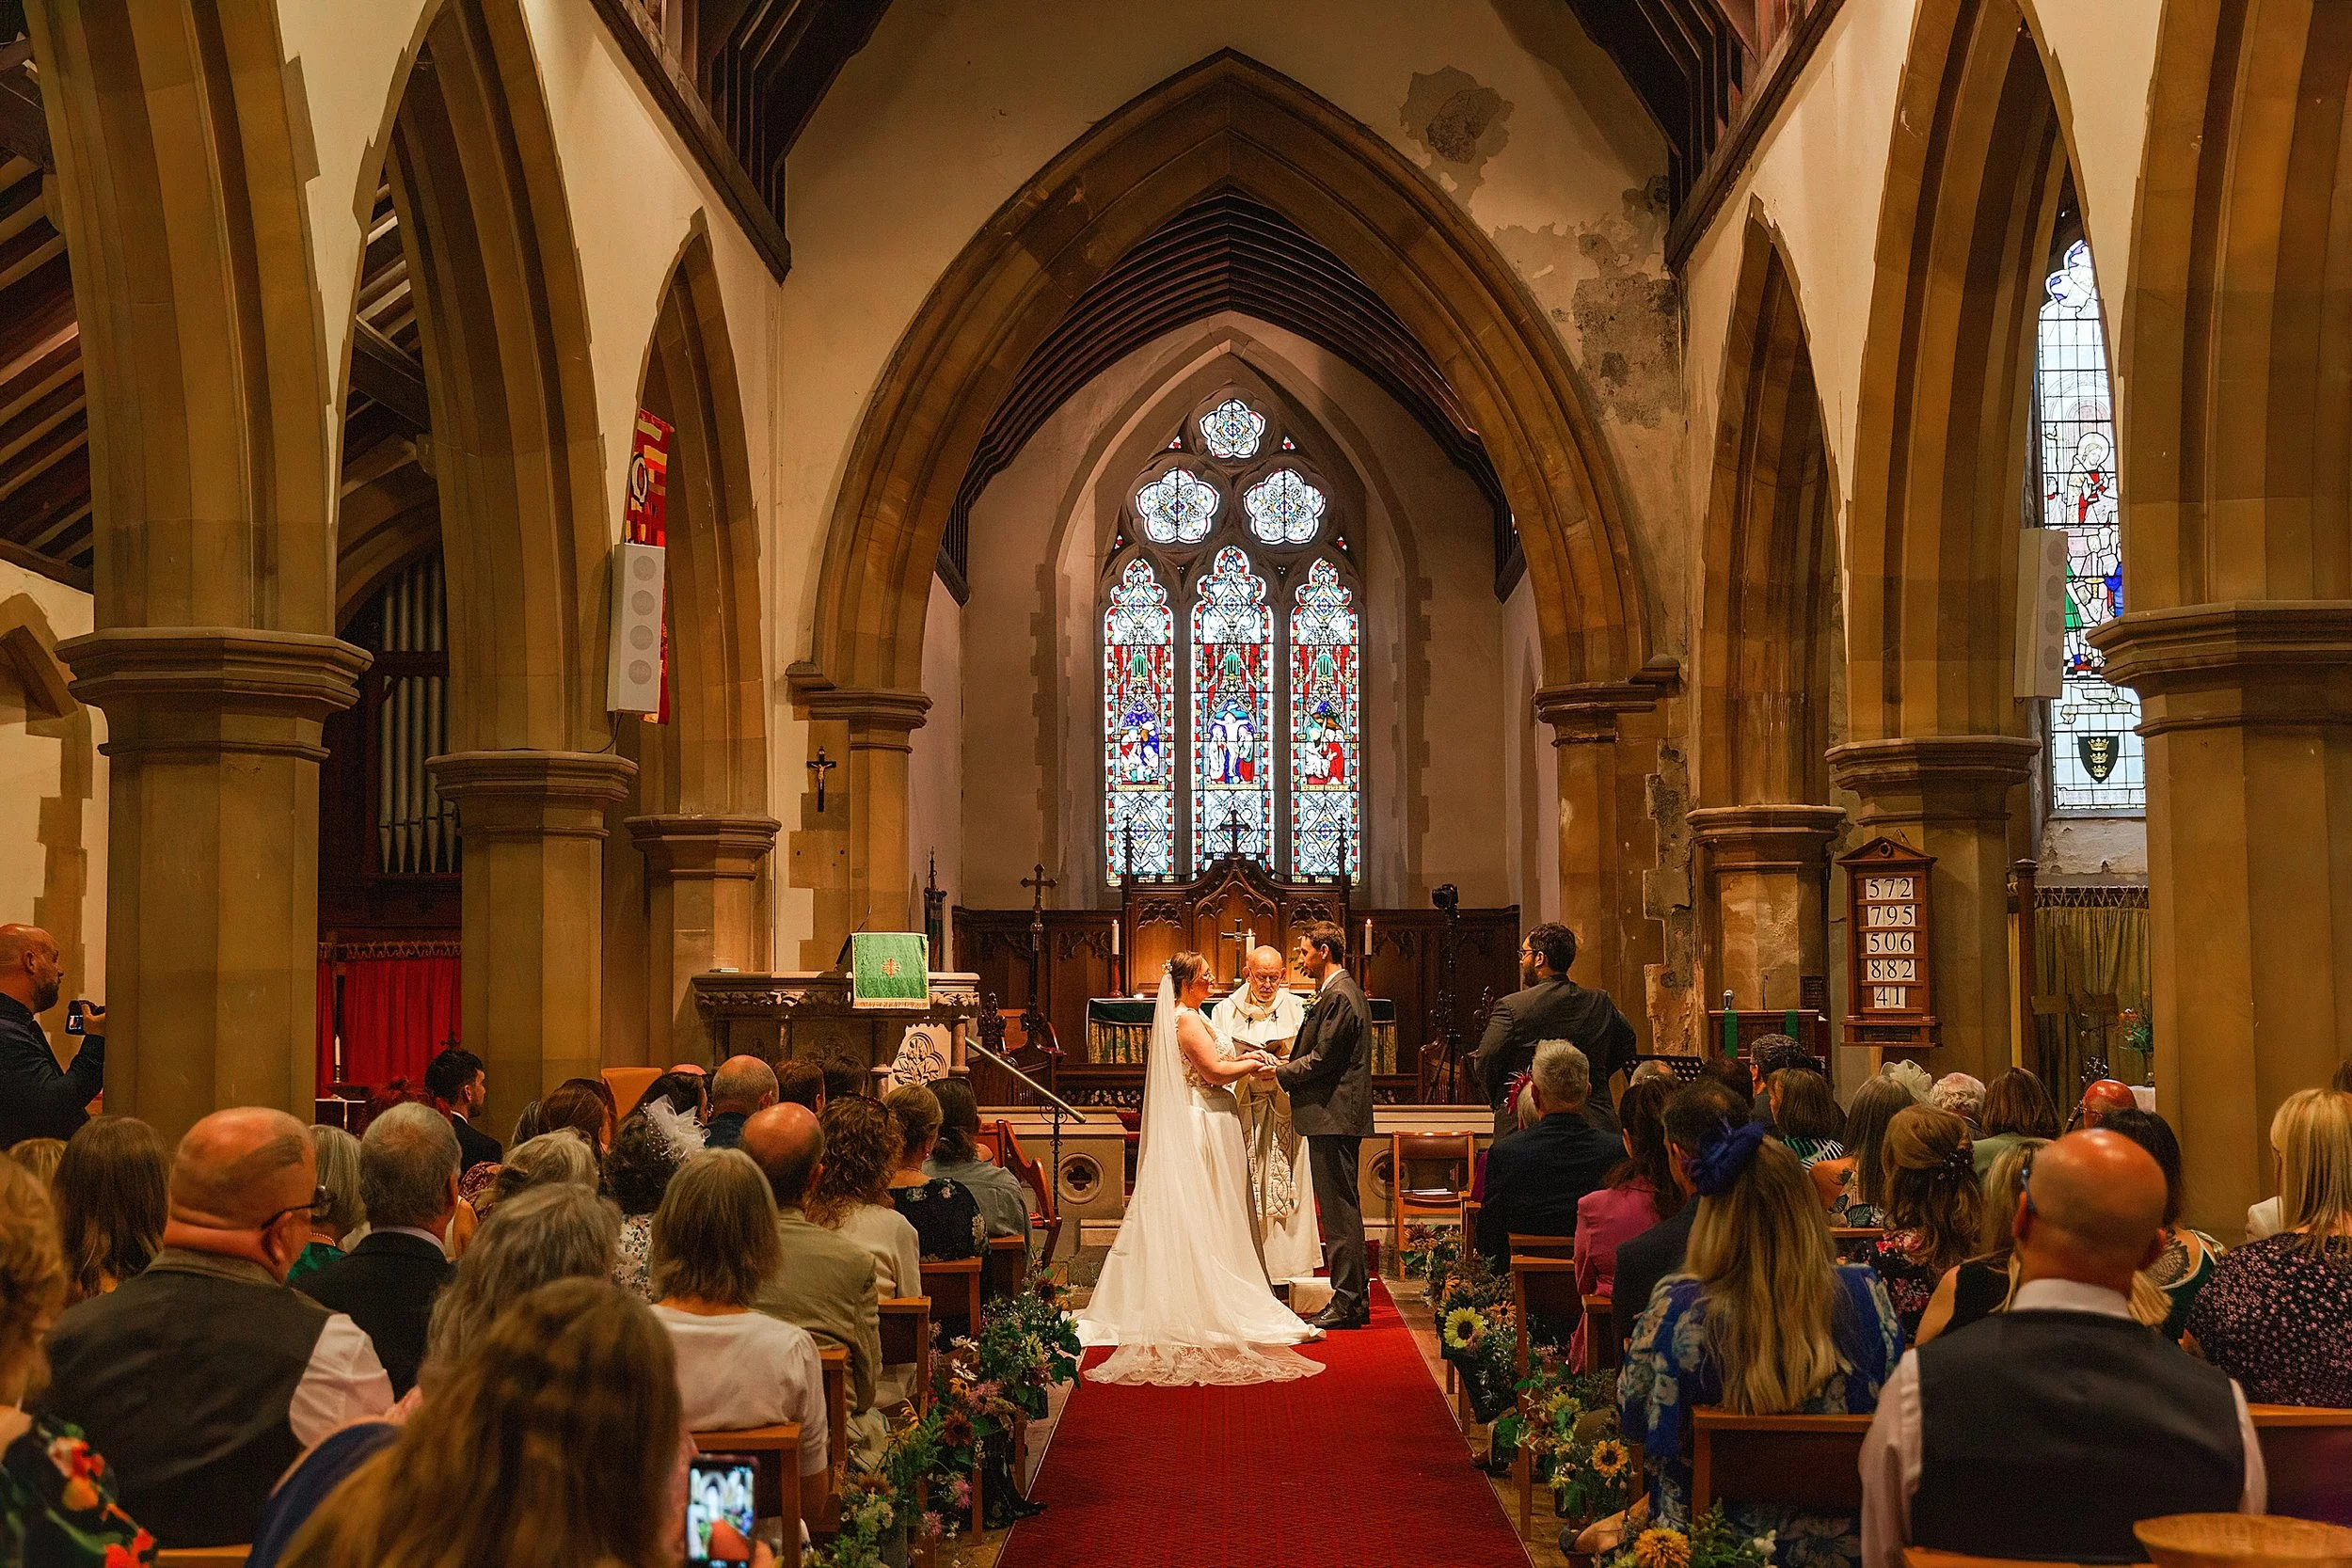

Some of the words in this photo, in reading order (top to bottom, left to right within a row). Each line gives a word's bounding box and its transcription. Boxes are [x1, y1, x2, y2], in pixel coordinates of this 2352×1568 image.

[1869, 879, 1911, 898] 572
[1870, 905, 1913, 926] 795
[1870, 931, 1912, 953] 506
[1871, 958, 1913, 979] 882
[1876, 986, 1901, 1006] 41
